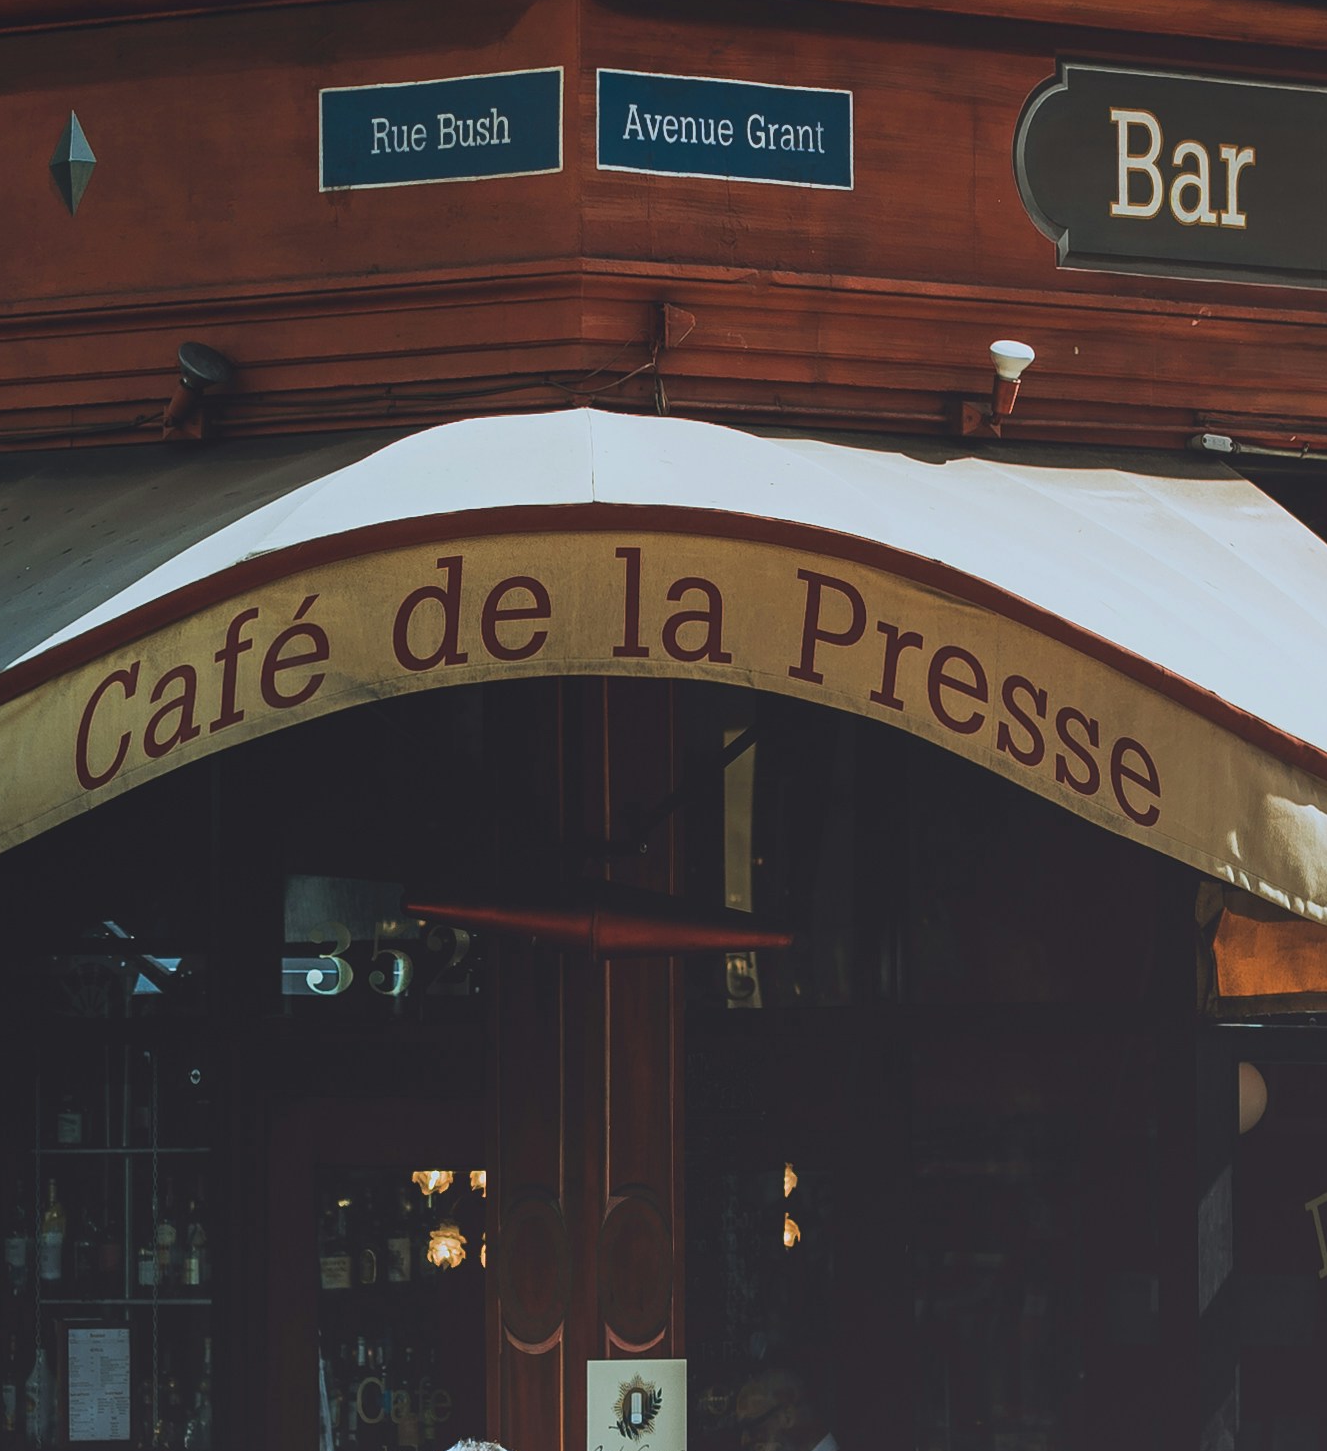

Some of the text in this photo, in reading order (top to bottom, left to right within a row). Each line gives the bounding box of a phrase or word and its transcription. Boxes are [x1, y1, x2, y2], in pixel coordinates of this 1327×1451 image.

[370, 107, 512, 155] Rue Bush
[622, 103, 827, 154] Avenue Grant
[1109, 106, 1256, 230] Bar
[74, 546, 1163, 828] Café de la Presse
[306, 922, 471, 996] 352
